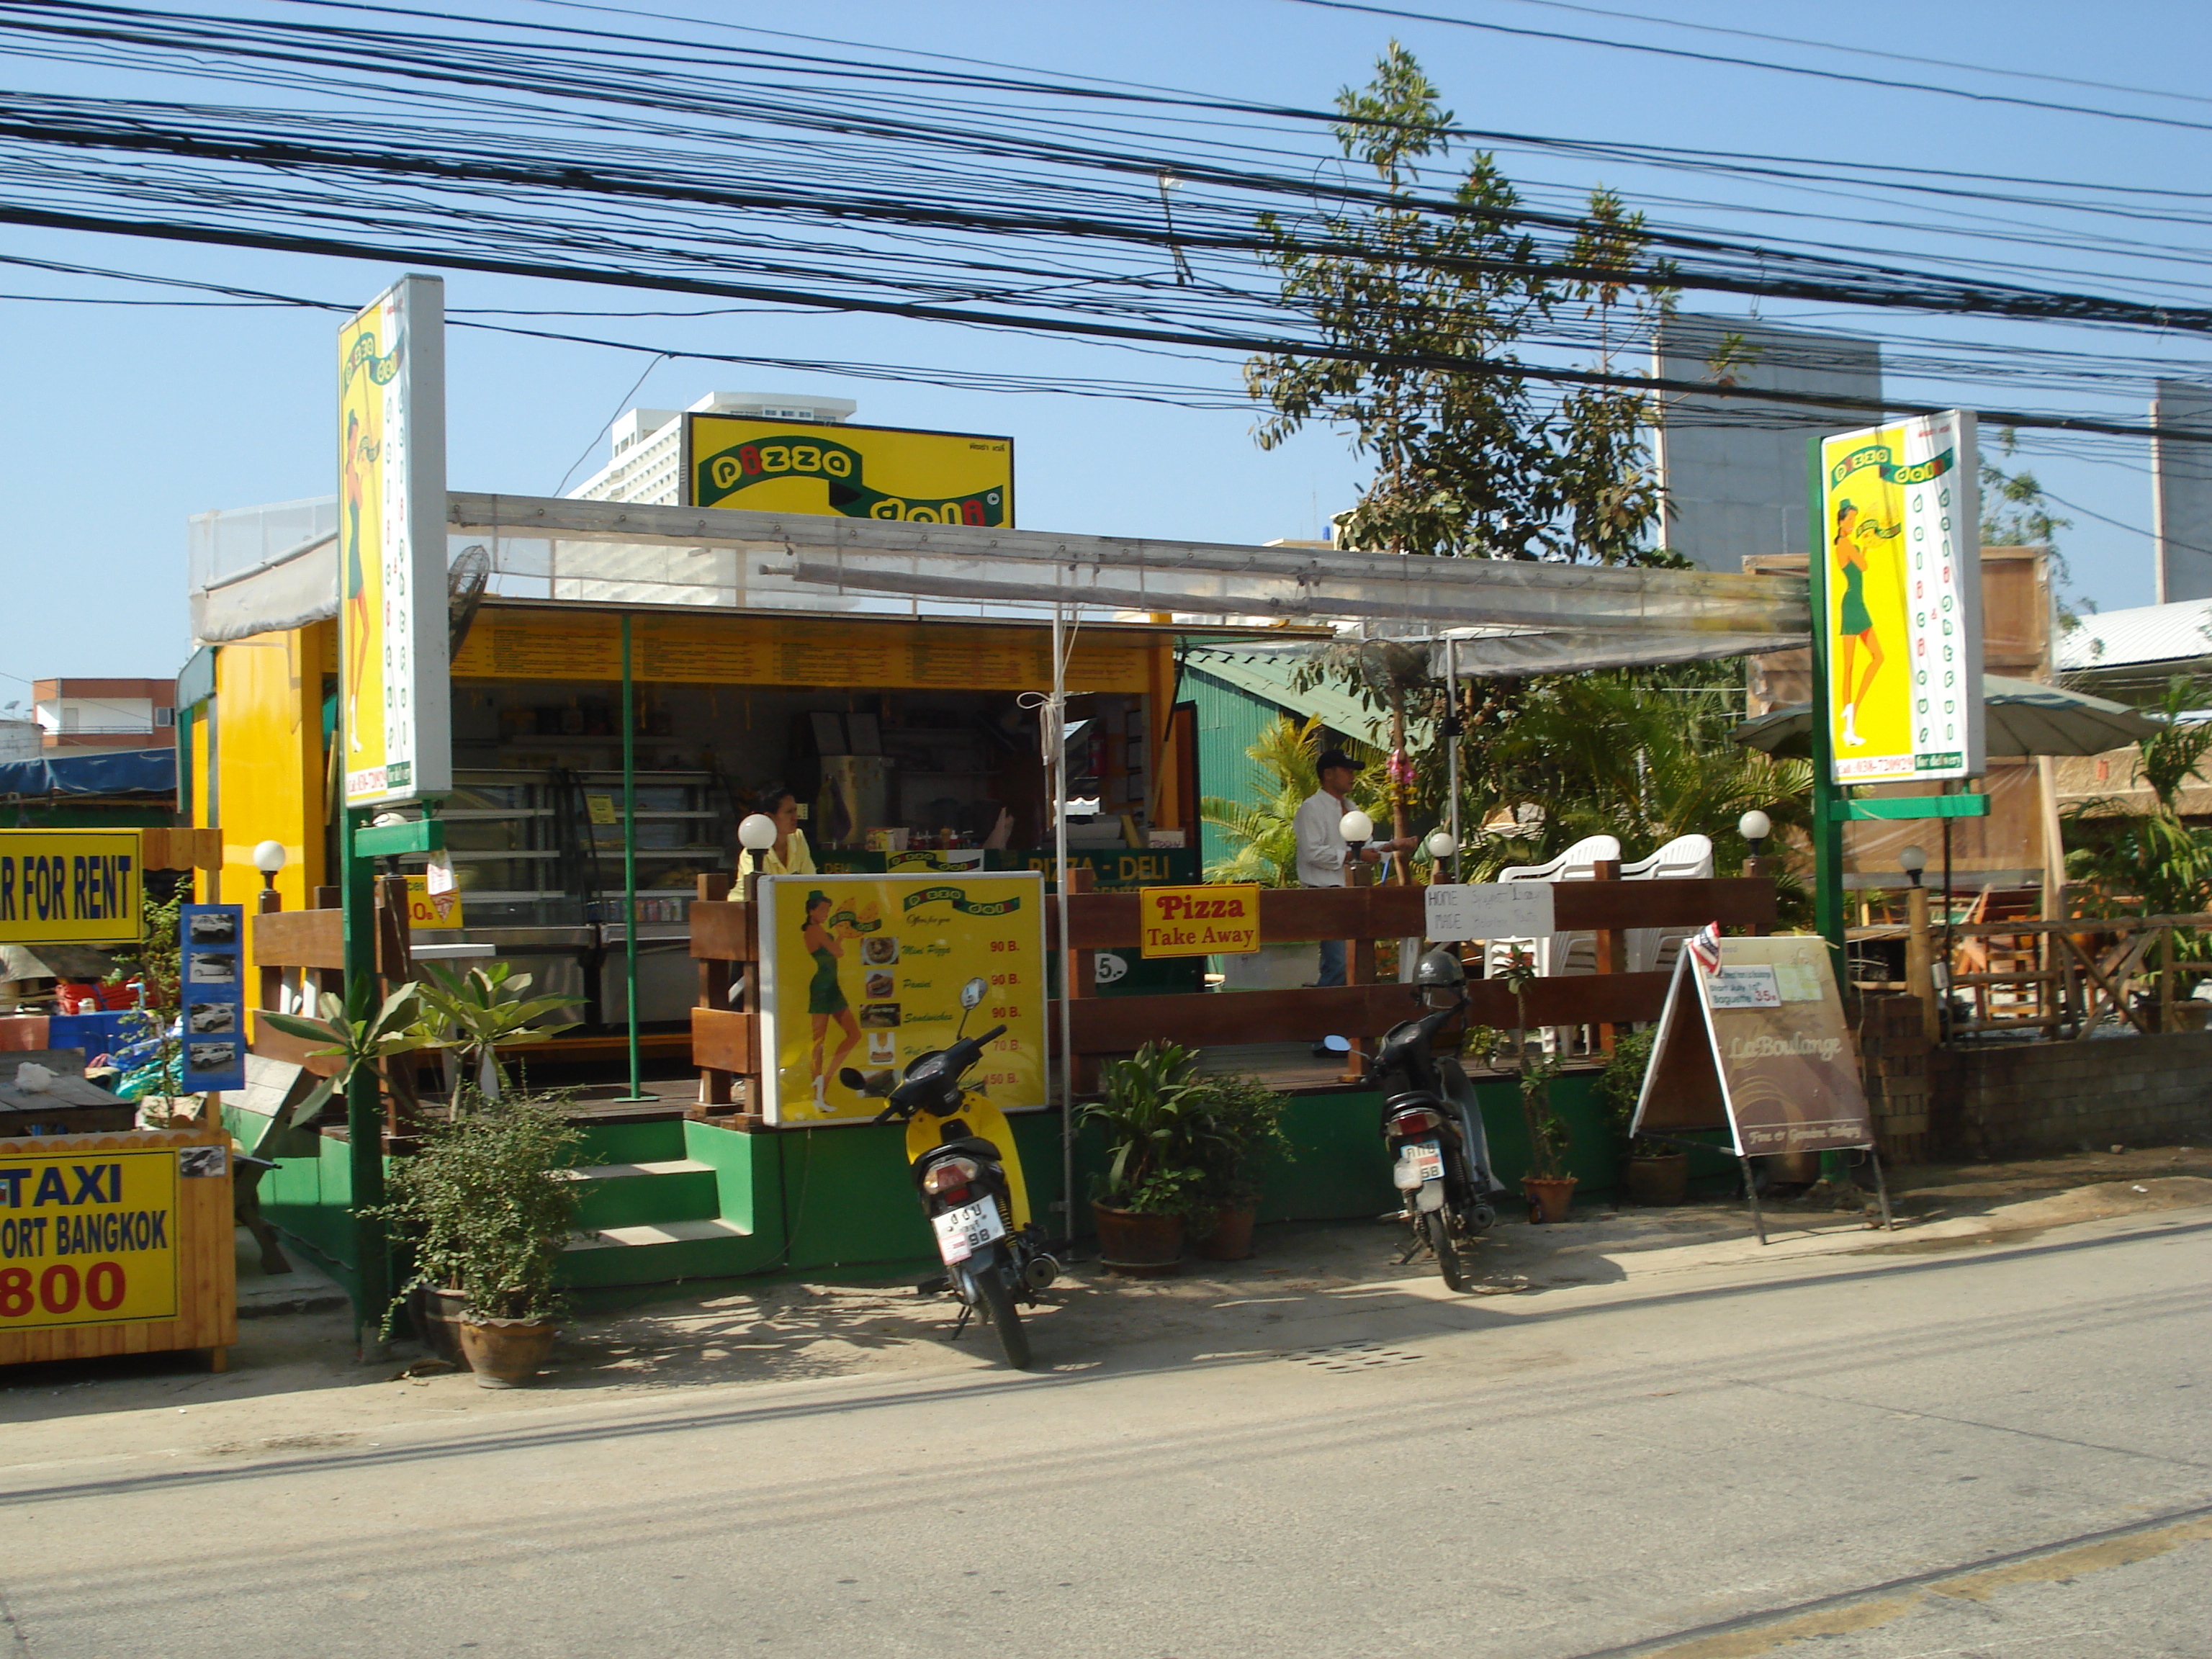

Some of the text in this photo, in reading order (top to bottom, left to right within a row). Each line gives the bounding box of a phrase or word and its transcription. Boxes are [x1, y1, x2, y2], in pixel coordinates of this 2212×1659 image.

[710, 445, 853, 489] pizza
[1835, 448, 1889, 482] pizza
[1119, 855, 1169, 881] DELI
[0, 855, 132, 921] R FOR RENT
[1428, 890, 1458, 906] HOME
[1156, 894, 1246, 920] Pizza
[1434, 913, 1462, 930] MADE
[990, 941, 1004, 952] 90
[1008, 940, 1020, 951] B.
[1147, 926, 1254, 948] Take Away
[992, 974, 1005, 985] 90
[1009, 974, 1020, 985] B.
[992, 1007, 1005, 1018] 90
[1010, 1007, 1022, 1017] B.
[1010, 1039, 1022, 1050] B.
[0, 1163, 122, 1209] TAXI
[56, 1210, 168, 1255] BANGKOK
[0, 1261, 127, 1318] 800
